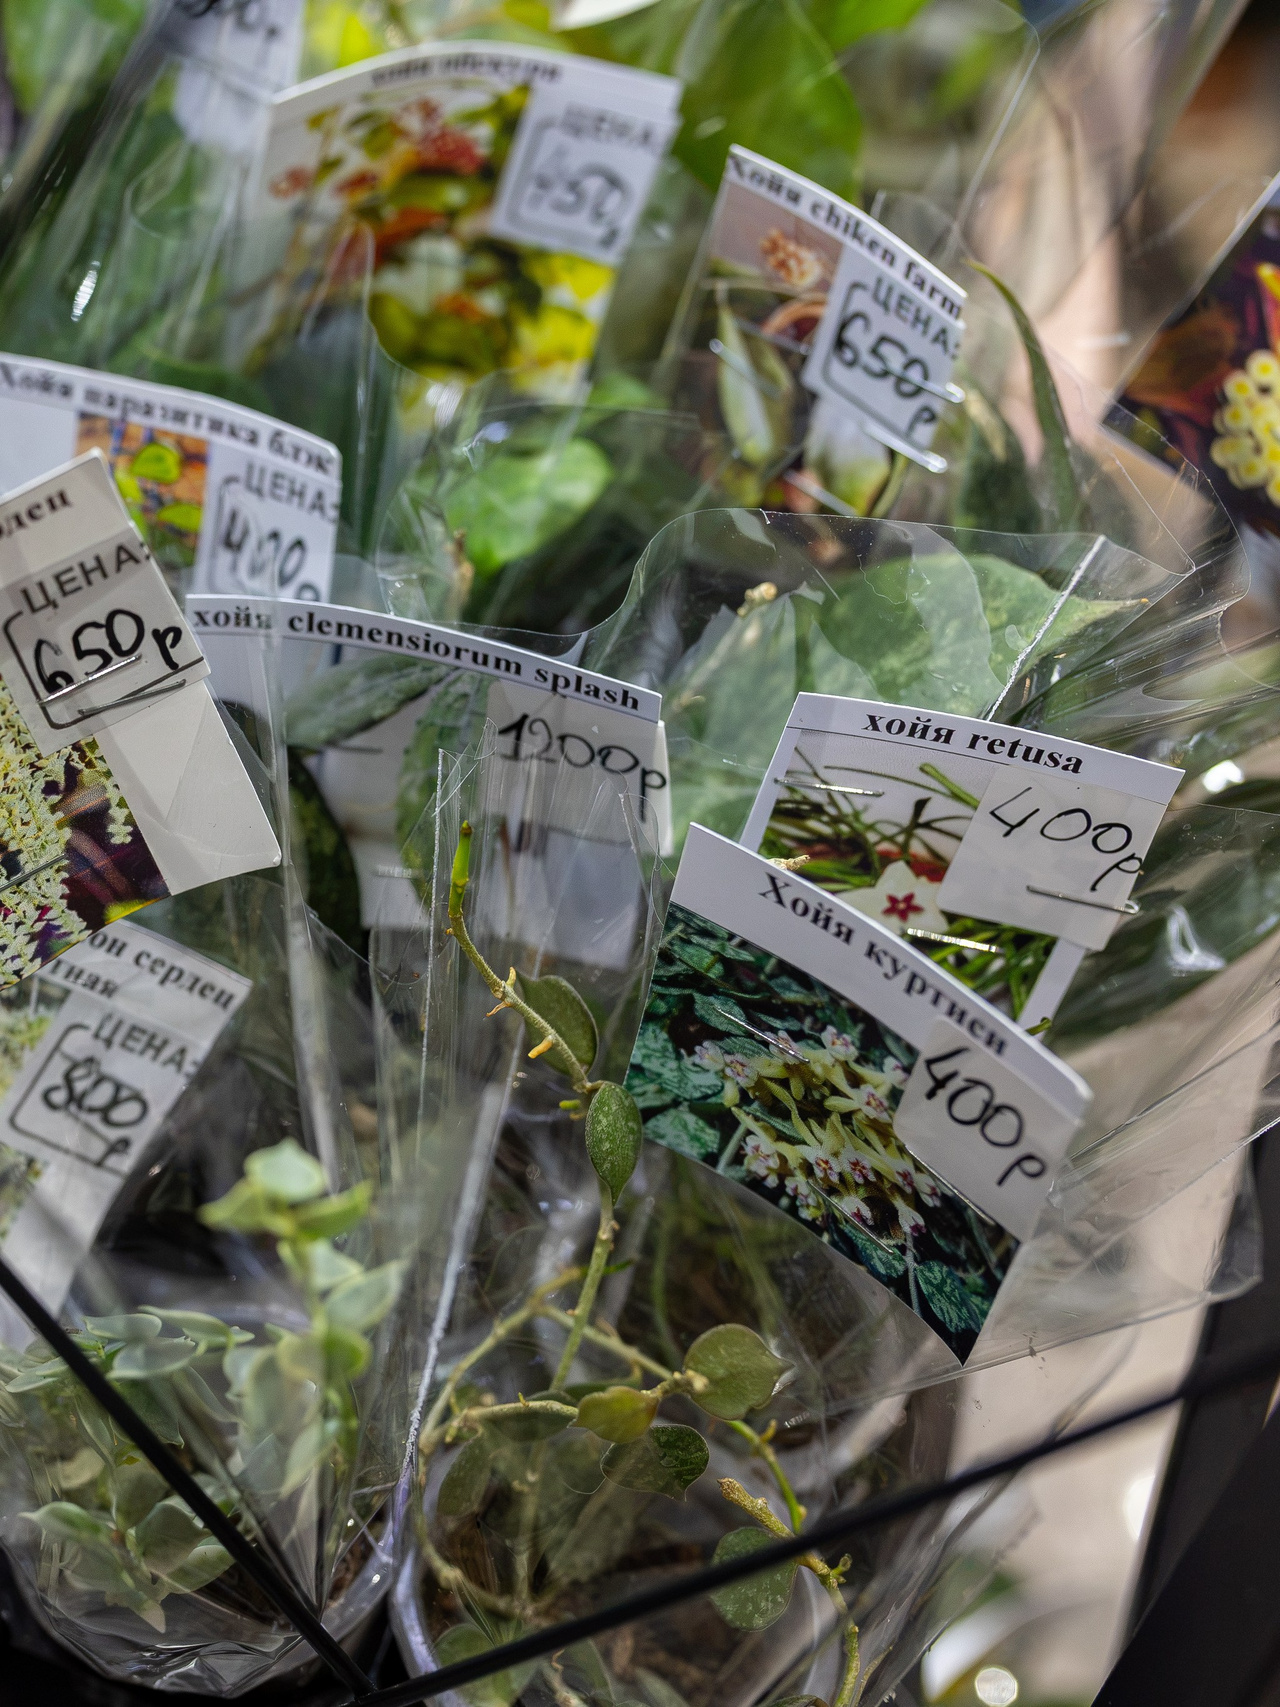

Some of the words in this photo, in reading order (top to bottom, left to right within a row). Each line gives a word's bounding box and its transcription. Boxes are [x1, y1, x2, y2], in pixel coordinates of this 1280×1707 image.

[809, 198, 898, 268] chiken
[902, 258, 962, 318] farm
[288, 614, 523, 676] clemensiorum
[534, 663, 642, 712] splash
[861, 712, 956, 748] хойя
[965, 732, 1084, 776] retusa
[758, 870, 856, 946] Хойя
[132, 950, 238, 1012] сердец
